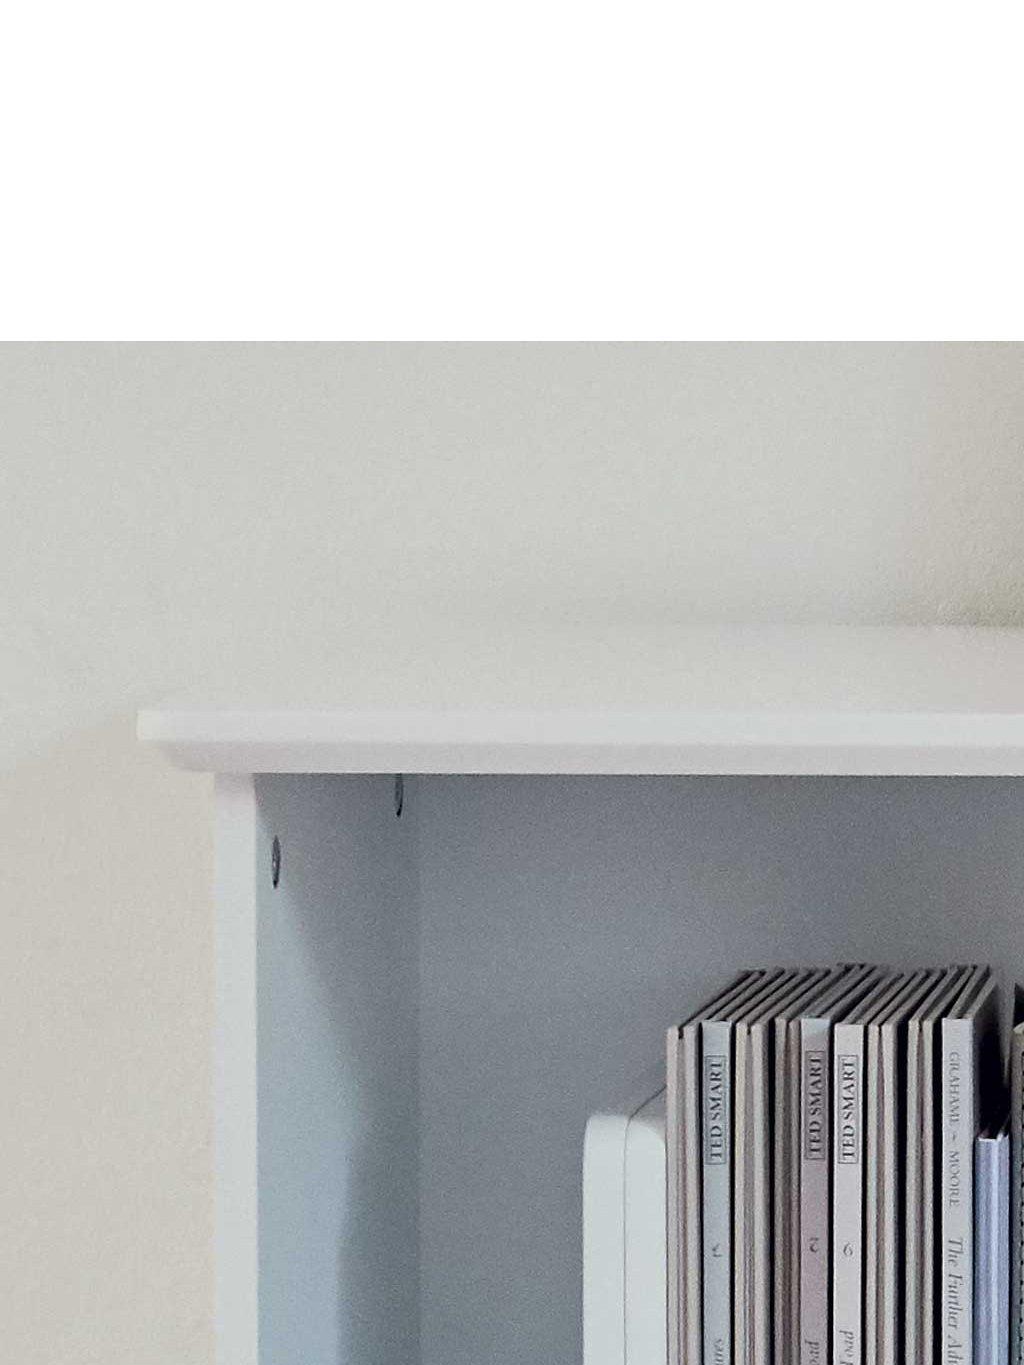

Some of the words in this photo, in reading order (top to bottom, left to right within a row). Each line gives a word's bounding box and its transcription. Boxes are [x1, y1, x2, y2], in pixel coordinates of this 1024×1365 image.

[709, 1061, 722, 1120] SMART
[808, 1056, 821, 1116] SMART
[841, 1060, 855, 1120] SMART
[948, 1051, 960, 1123] GRAHAME
[710, 1126, 723, 1159] TED
[809, 1121, 822, 1154] TED
[841, 1126, 855, 1159] TED
[948, 1151, 960, 1206] MOORE
[947, 1238, 964, 1266] The
[946, 1275, 963, 1330] Further
